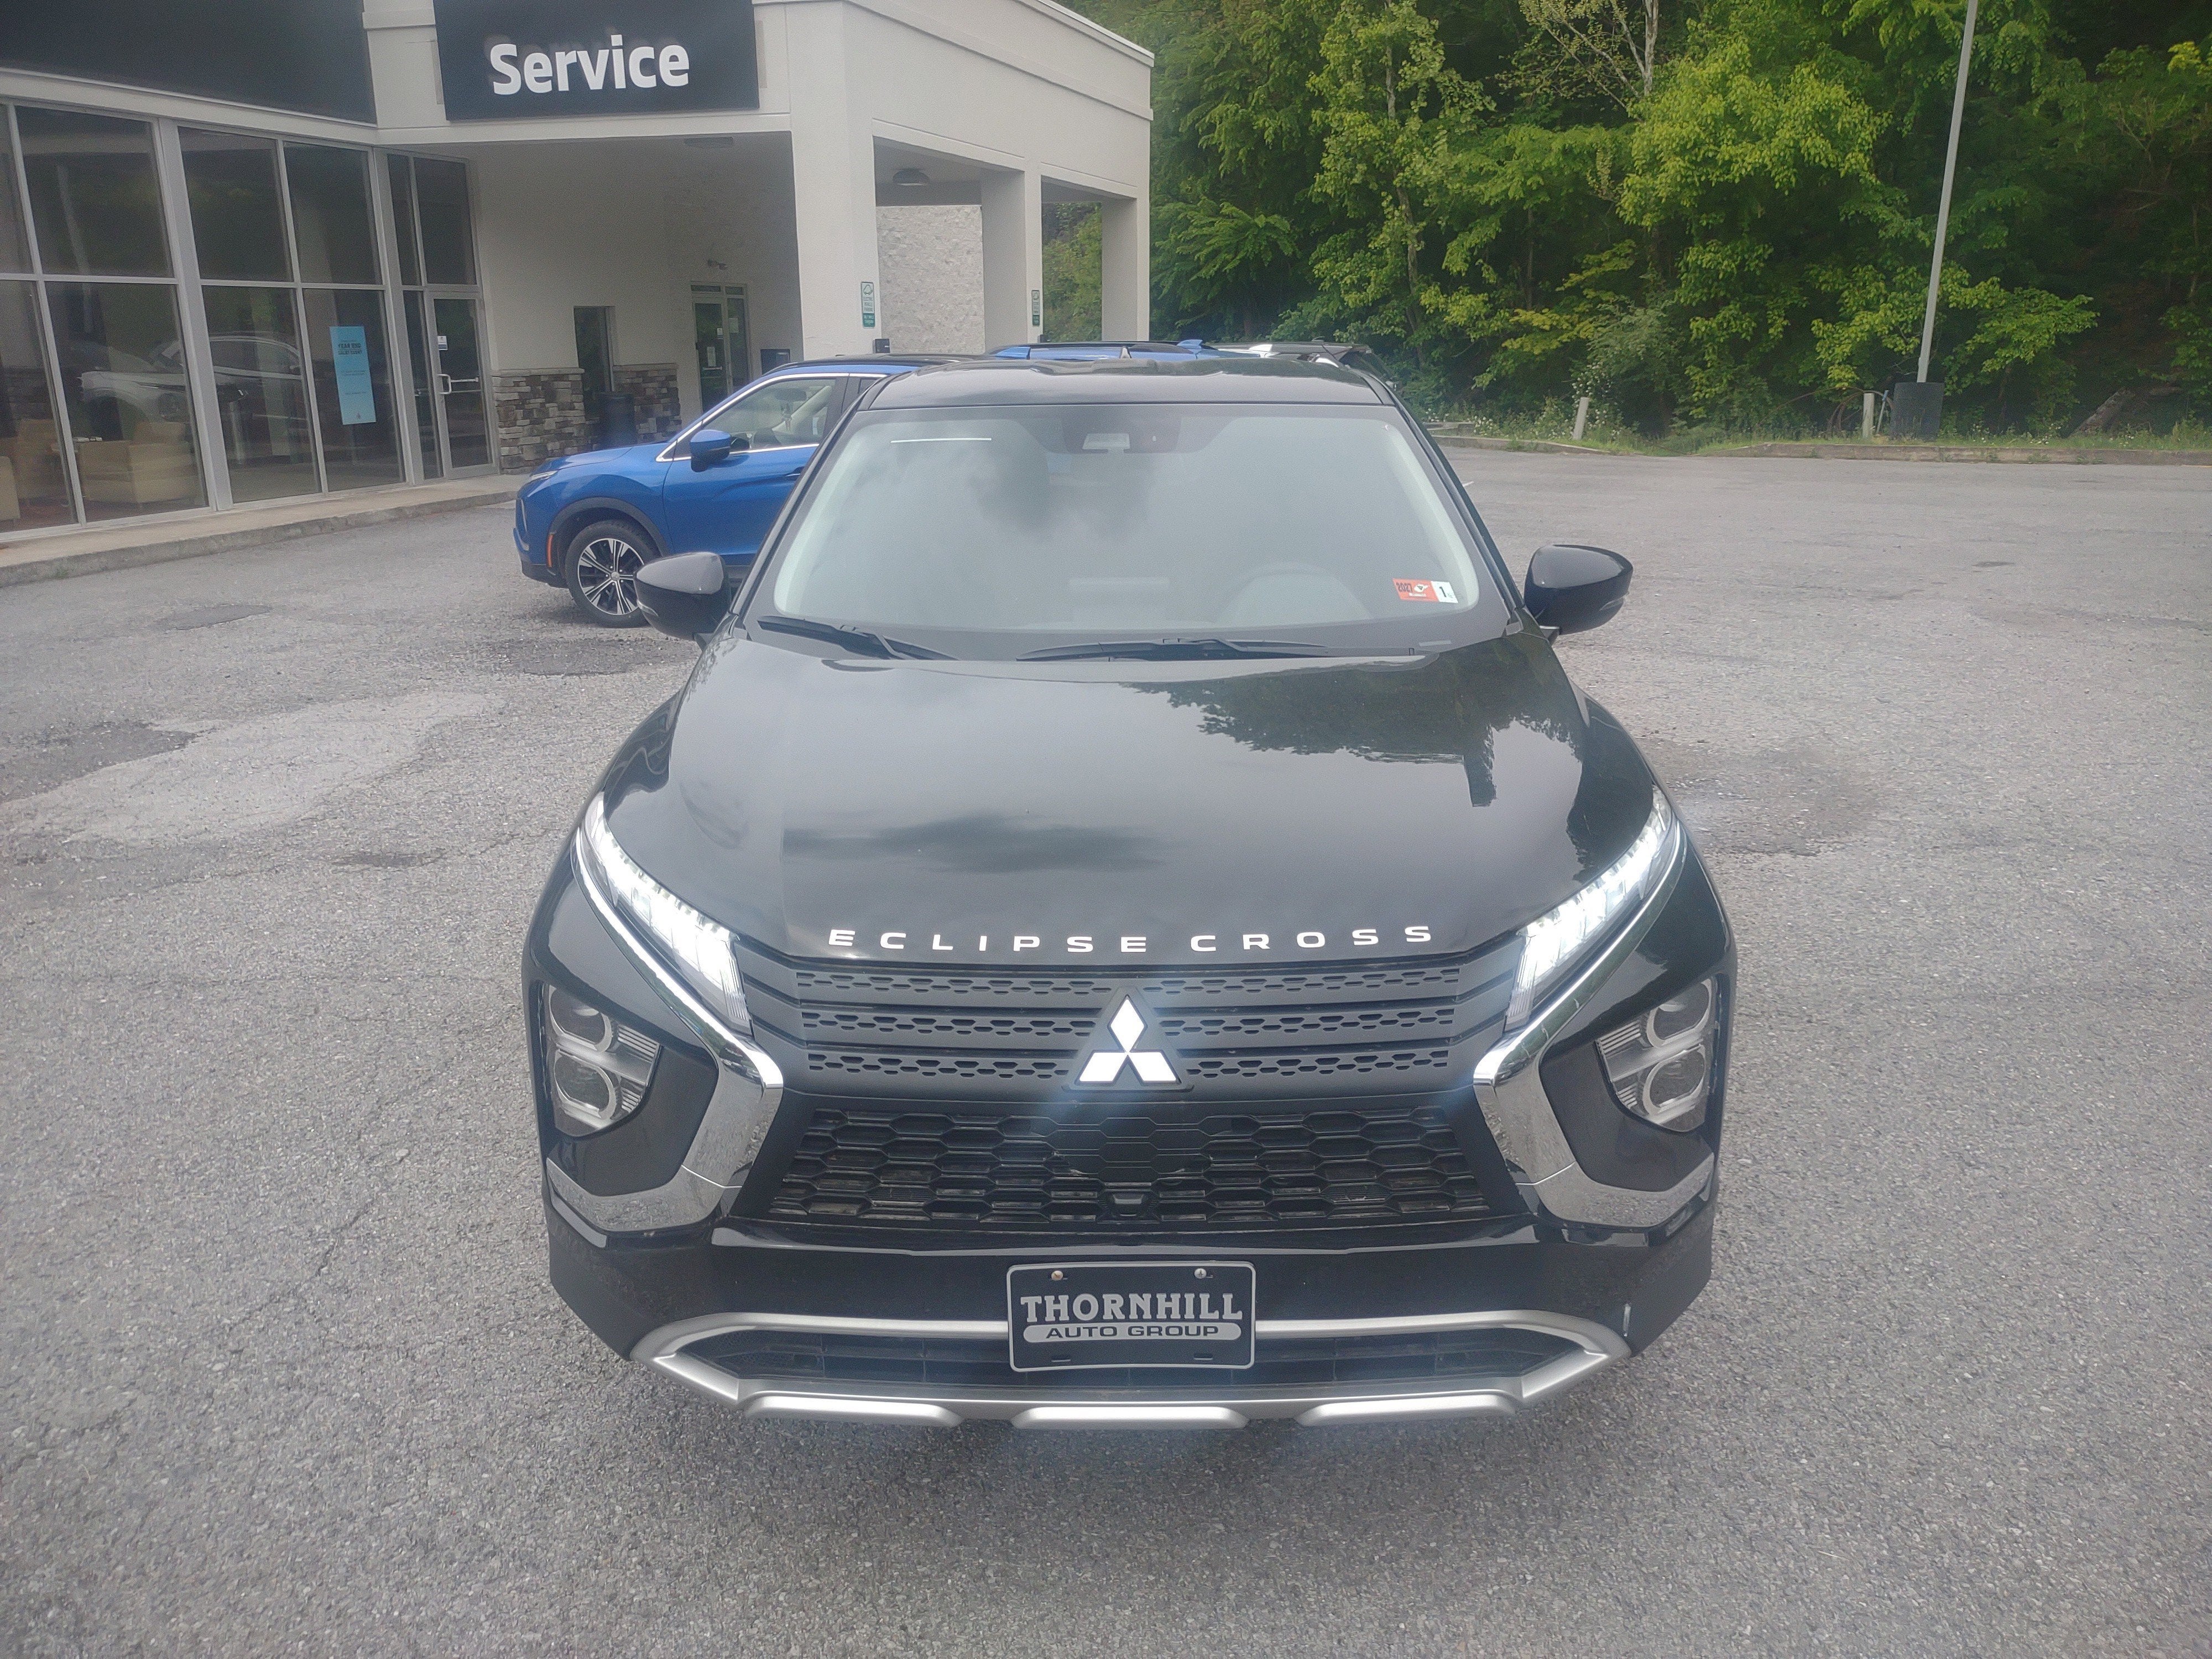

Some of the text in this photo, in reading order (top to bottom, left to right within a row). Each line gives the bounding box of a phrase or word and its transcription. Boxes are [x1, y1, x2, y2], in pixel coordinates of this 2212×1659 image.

[490, 34, 690, 95] Service
[1396, 582, 1447, 598] 2027 1
[828, 926, 1432, 953] ECLIPSE CROSS
[1020, 1293, 1243, 1322] THORNHILL
[1045, 1325, 1219, 1339] AUTO GROUP
